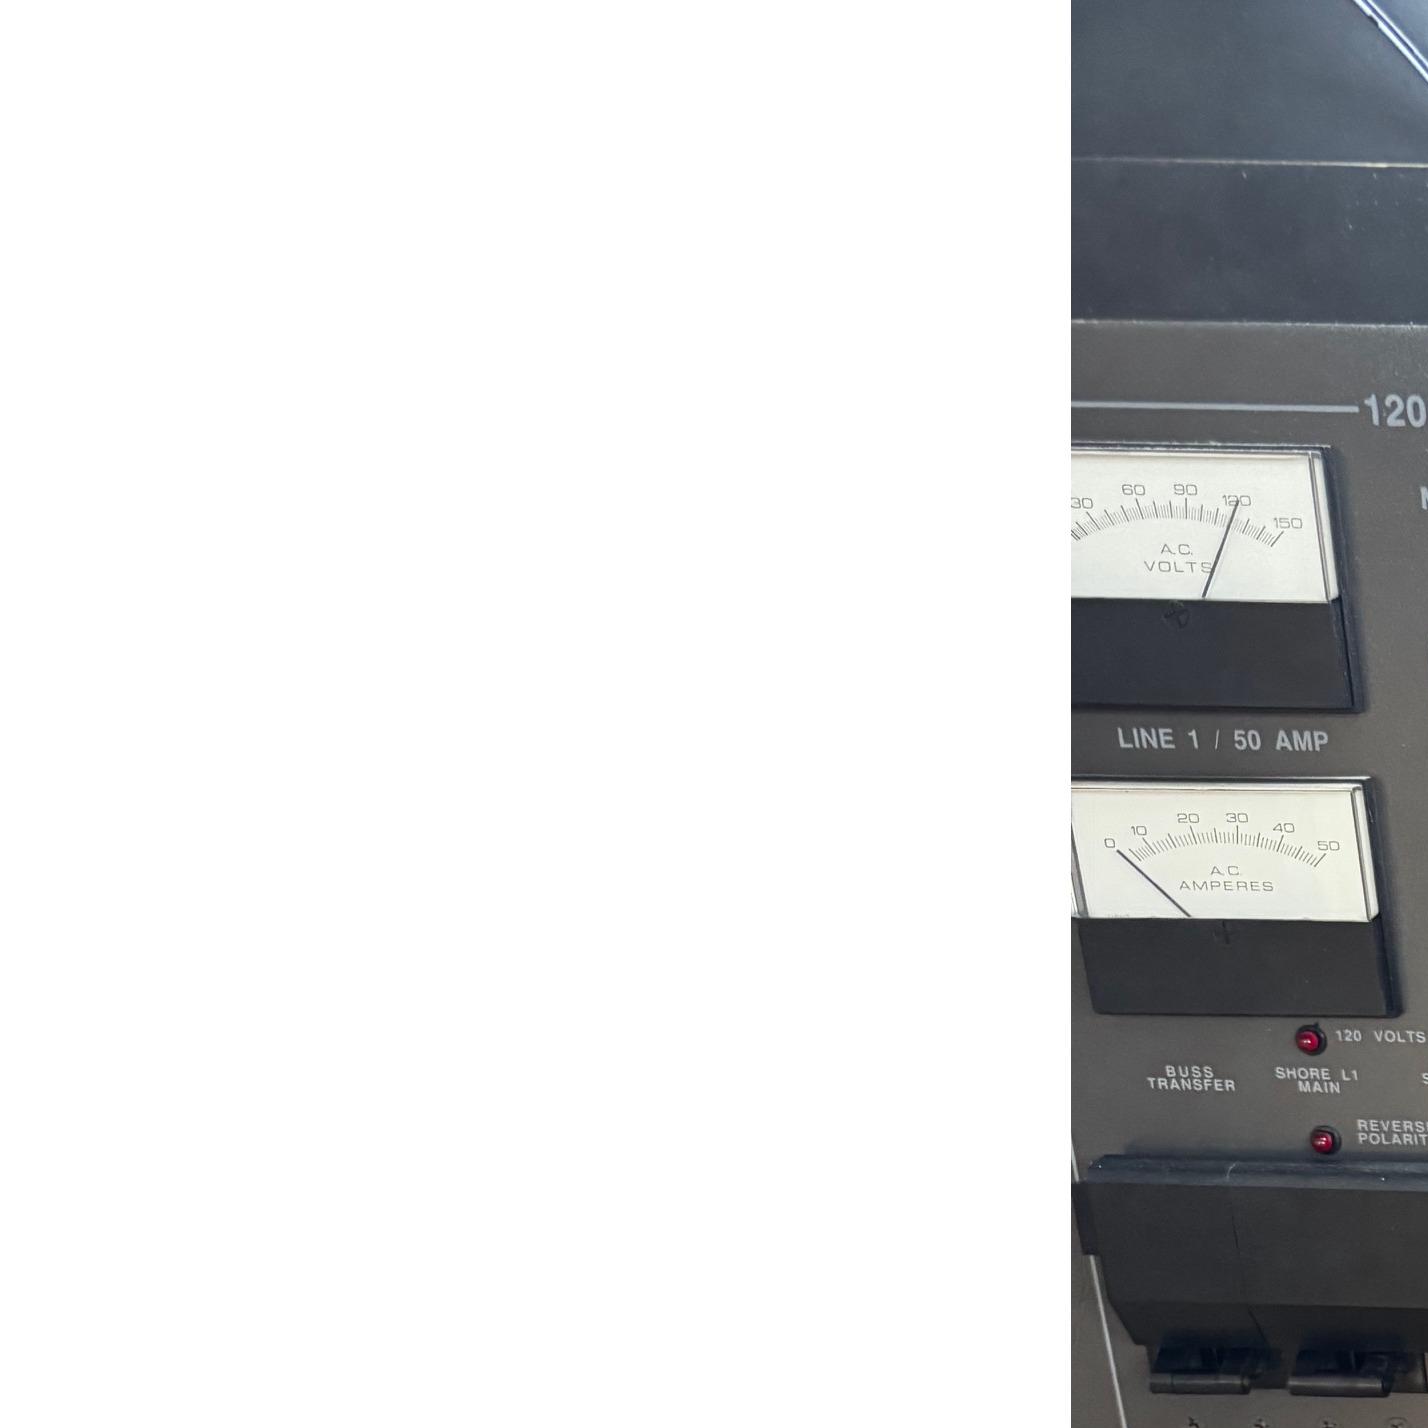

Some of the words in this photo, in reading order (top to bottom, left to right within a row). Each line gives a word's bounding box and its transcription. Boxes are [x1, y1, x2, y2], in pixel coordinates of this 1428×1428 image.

[1364, 395, 1427, 428] 120
[1122, 484, 1145, 496] 60
[1174, 484, 1198, 496] 90
[1222, 495, 1251, 506] 120
[1274, 517, 1303, 529] 150
[1144, 561, 1213, 573] VOLTS
[1118, 728, 1175, 750] LINE
[1188, 729, 1198, 750] 1
[1233, 729, 1262, 751] 50
[1275, 731, 1329, 752] AMP
[1179, 880, 1274, 892] AMPERES
[1335, 1031, 1362, 1042] 120
[1374, 1031, 1426, 1044] VOLTS
[1166, 1066, 1213, 1078] BUSS
[1275, 1067, 1330, 1080] SHORE
[1342, 1069, 1358, 1081] L1
[1147, 1078, 1235, 1092] TRANSFER
[1298, 1080, 1341, 1094] MAIN
